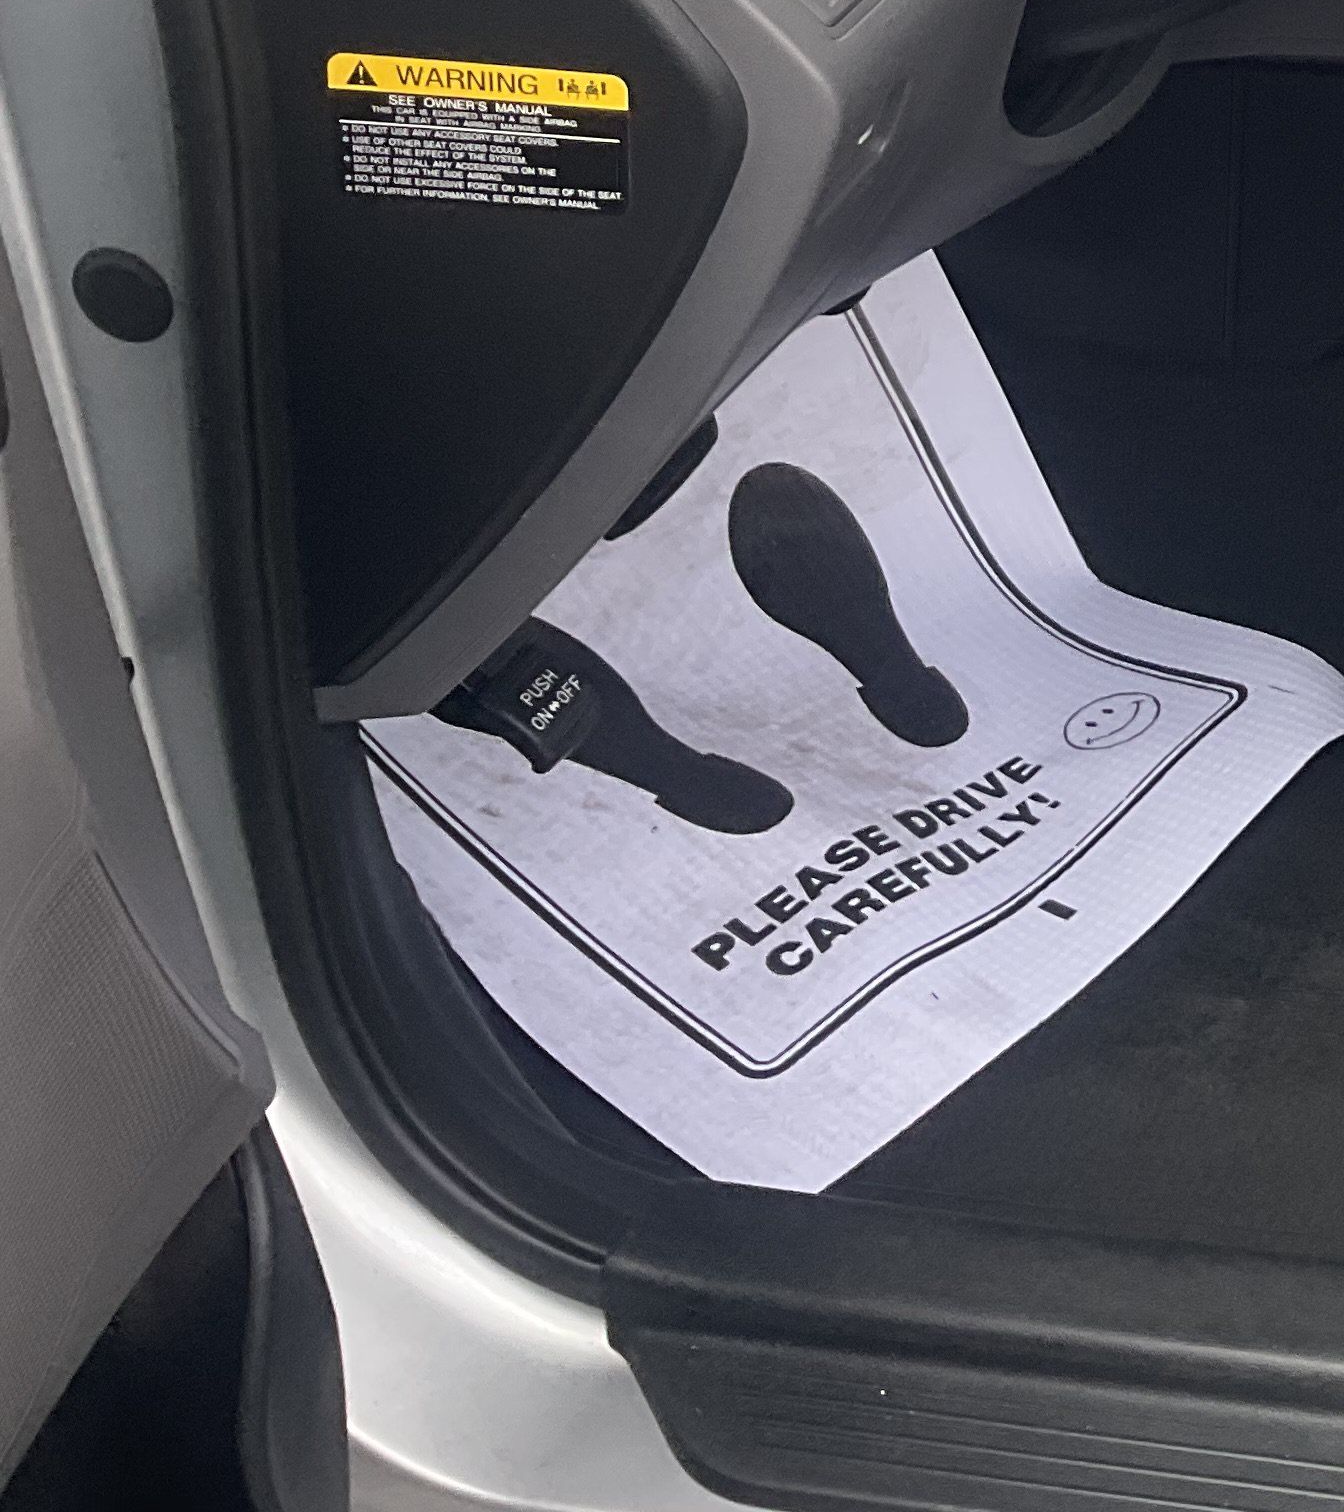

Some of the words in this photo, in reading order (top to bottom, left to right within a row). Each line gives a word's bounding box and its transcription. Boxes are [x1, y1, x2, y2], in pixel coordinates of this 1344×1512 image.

[395, 64, 539, 96] WARNING
[371, 105, 392, 114] THIS
[395, 106, 415, 115] CAR
[388, 94, 416, 106] SEE
[423, 96, 488, 112] OWNER'S
[495, 102, 552, 117] MANUAL
[408, 116, 432, 124] SEAT
[351, 124, 366, 133] DO
[368, 125, 388, 134] NOT
[390, 126, 409, 136] USE
[411, 128, 432, 137] ANY
[433, 130, 491, 141] ACCESSORY
[493, 134, 516, 143] SEAT
[351, 135, 371, 144] USE
[372, 136, 387, 145] OF
[388, 137, 421, 148] OTHER
[423, 139, 447, 149] SEAT
[448, 141, 488, 152] COVERS
[489, 145, 522, 155] COULD
[352, 144, 391, 155] REDUCE
[393, 147, 413, 156] THE
[414, 148, 449, 159] EFFECT
[452, 151, 465, 160] OF
[467, 152, 487, 162] THE
[353, 154, 368, 163] DO
[370, 155, 390, 164] NOT
[392, 157, 430, 168] INSTALL
[432, 160, 453, 169] ANY
[455, 162, 519, 174] ACCESSORIES
[520, 166, 536, 175] ON
[537, 167, 557, 177] THE
[376, 165, 392, 174] OR
[393, 166, 420, 175] NEAR
[422, 168, 441, 177] THE
[354, 174, 369, 182] DO
[371, 175, 391, 184] NOT
[392, 176, 413, 185] USE
[414, 177, 465, 189] EXCESSIVE
[467, 181, 499, 192] FORCE
[501, 184, 516, 193] ON
[517, 184, 537, 195] THE
[538, 186, 560, 196] SIDE
[561, 188, 575, 197] OF
[577, 189, 596, 199] THE
[354, 185, 375, 194] FOR
[376, 186, 421, 196] FURTHER
[492, 194, 510, 203] SEE
[512, 195, 557, 206] OWNER'S
[519, 668, 560, 708] PUSH
[531, 706, 555, 731] ON
[556, 673, 583, 705] OFF
[691, 824, 903, 971] PLEASE
[892, 755, 1044, 840] DRIVE
[765, 791, 1062, 976] CAREFULLY!
